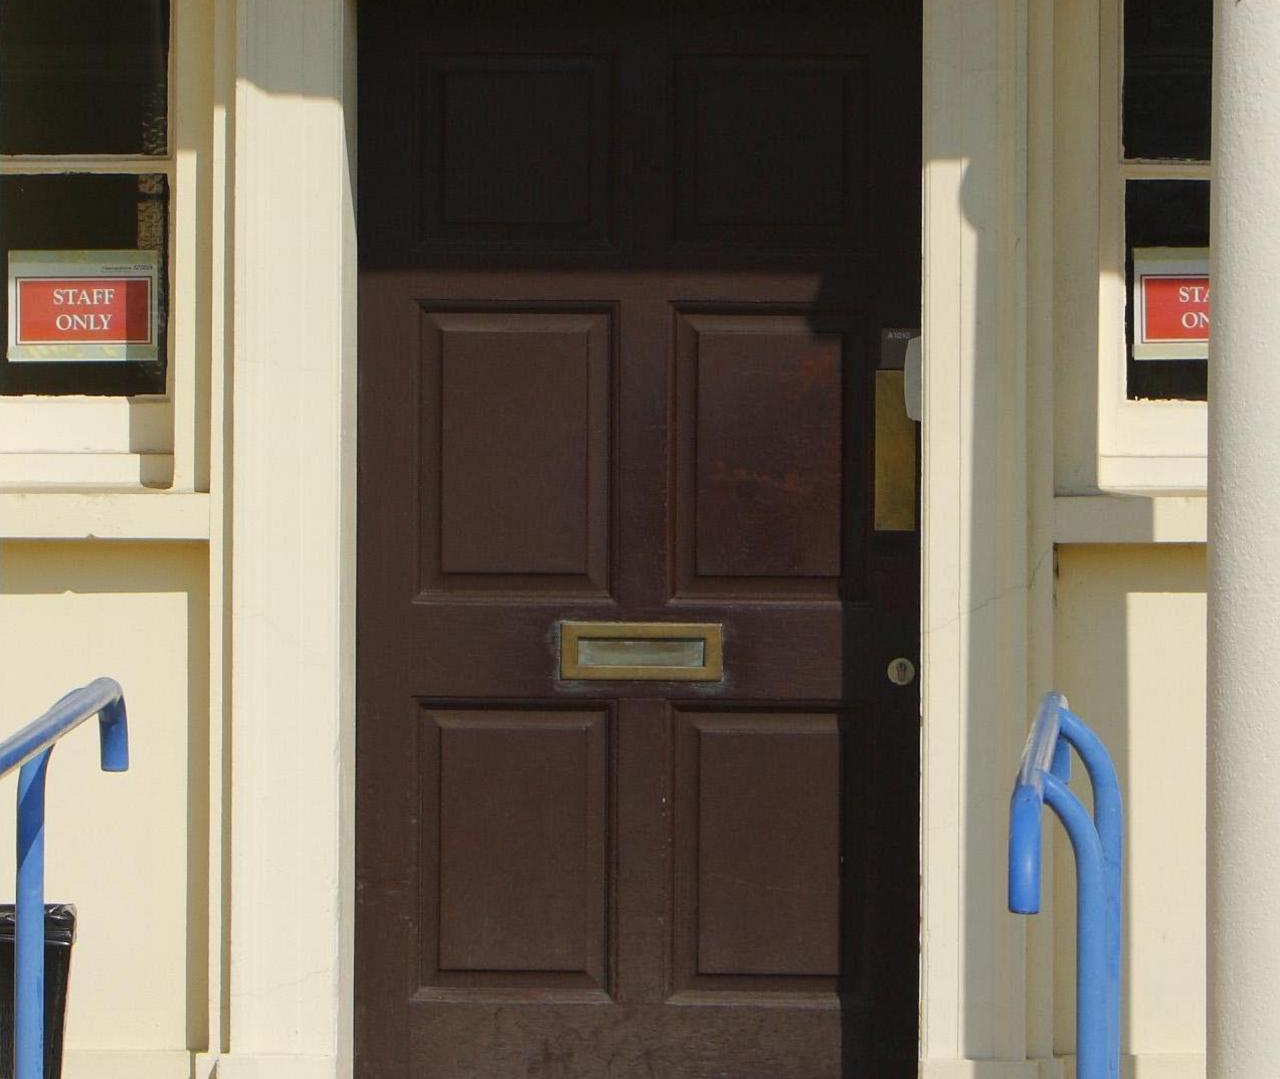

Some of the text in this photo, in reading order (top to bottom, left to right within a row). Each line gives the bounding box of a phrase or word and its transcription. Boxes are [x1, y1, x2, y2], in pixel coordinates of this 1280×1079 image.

[52, 288, 115, 305] STAFF
[1178, 286, 1210, 303] ST
[55, 314, 112, 331] ONLY
[1181, 311, 1210, 329] ON
